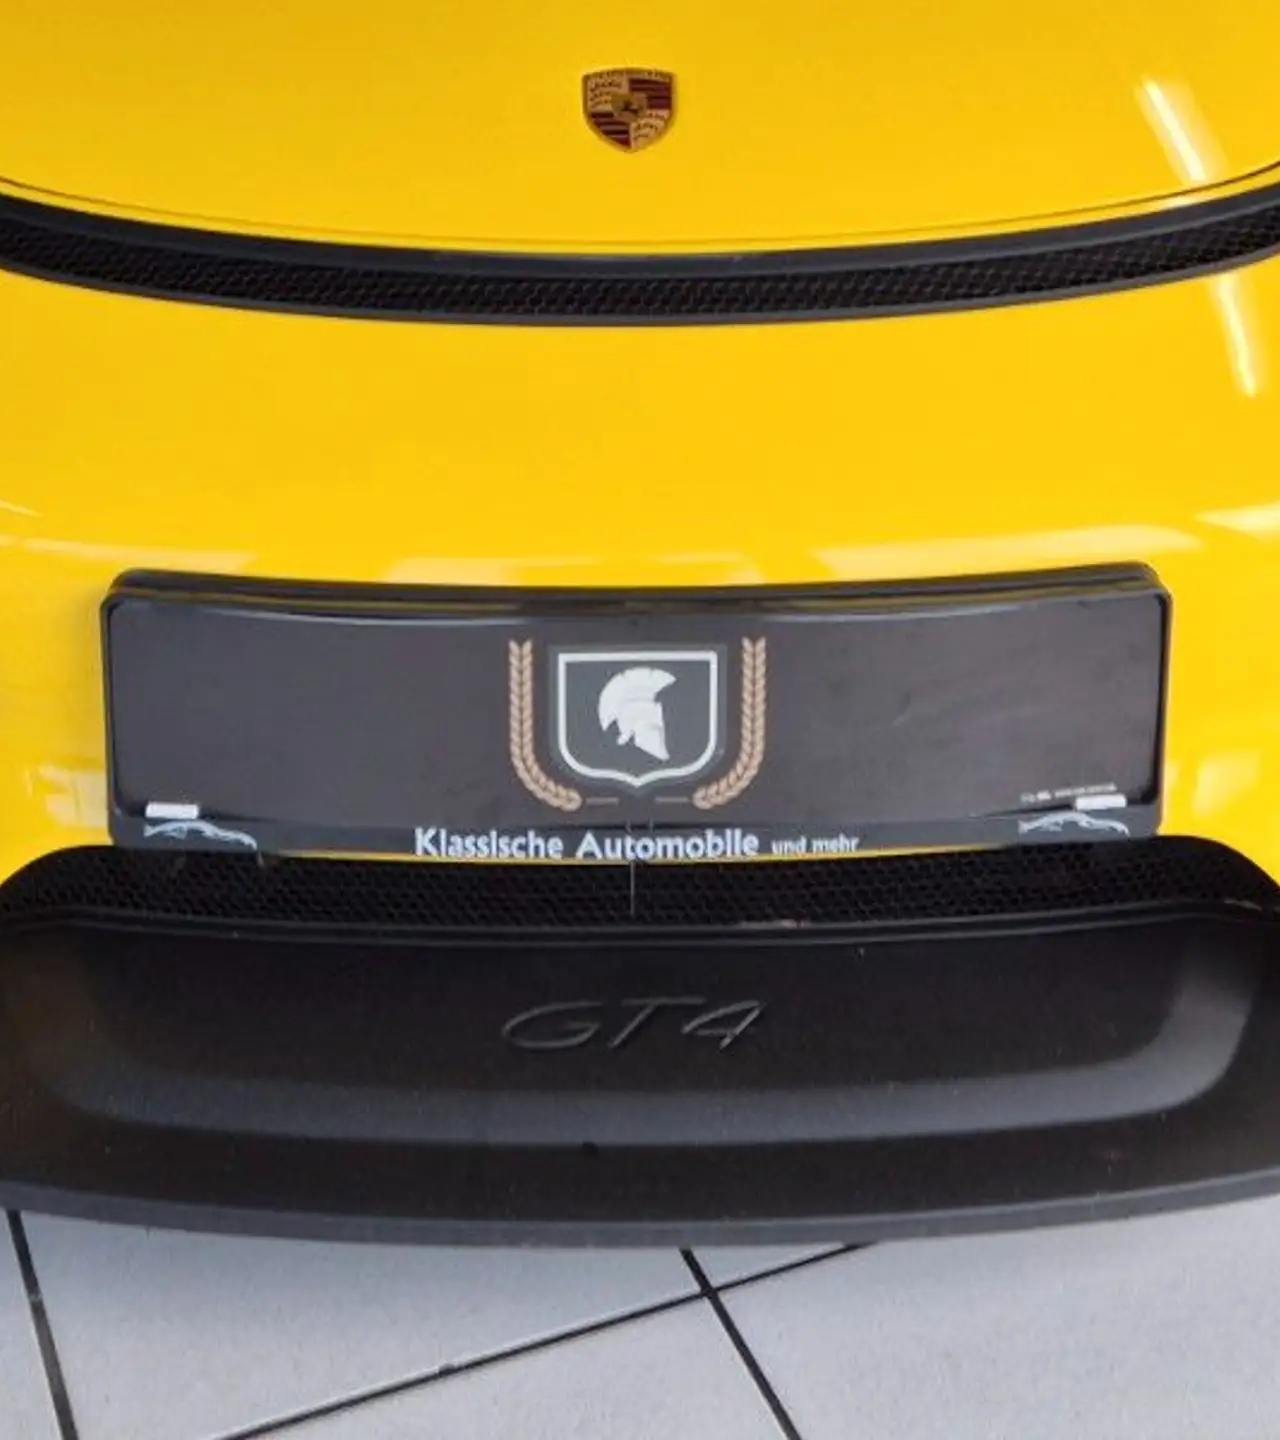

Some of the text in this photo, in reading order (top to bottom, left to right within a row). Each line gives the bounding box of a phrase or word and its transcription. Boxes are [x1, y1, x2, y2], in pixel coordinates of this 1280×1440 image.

[414, 826, 860, 860] Klassische Automobile und mehr
[501, 996, 767, 1050] GT4
